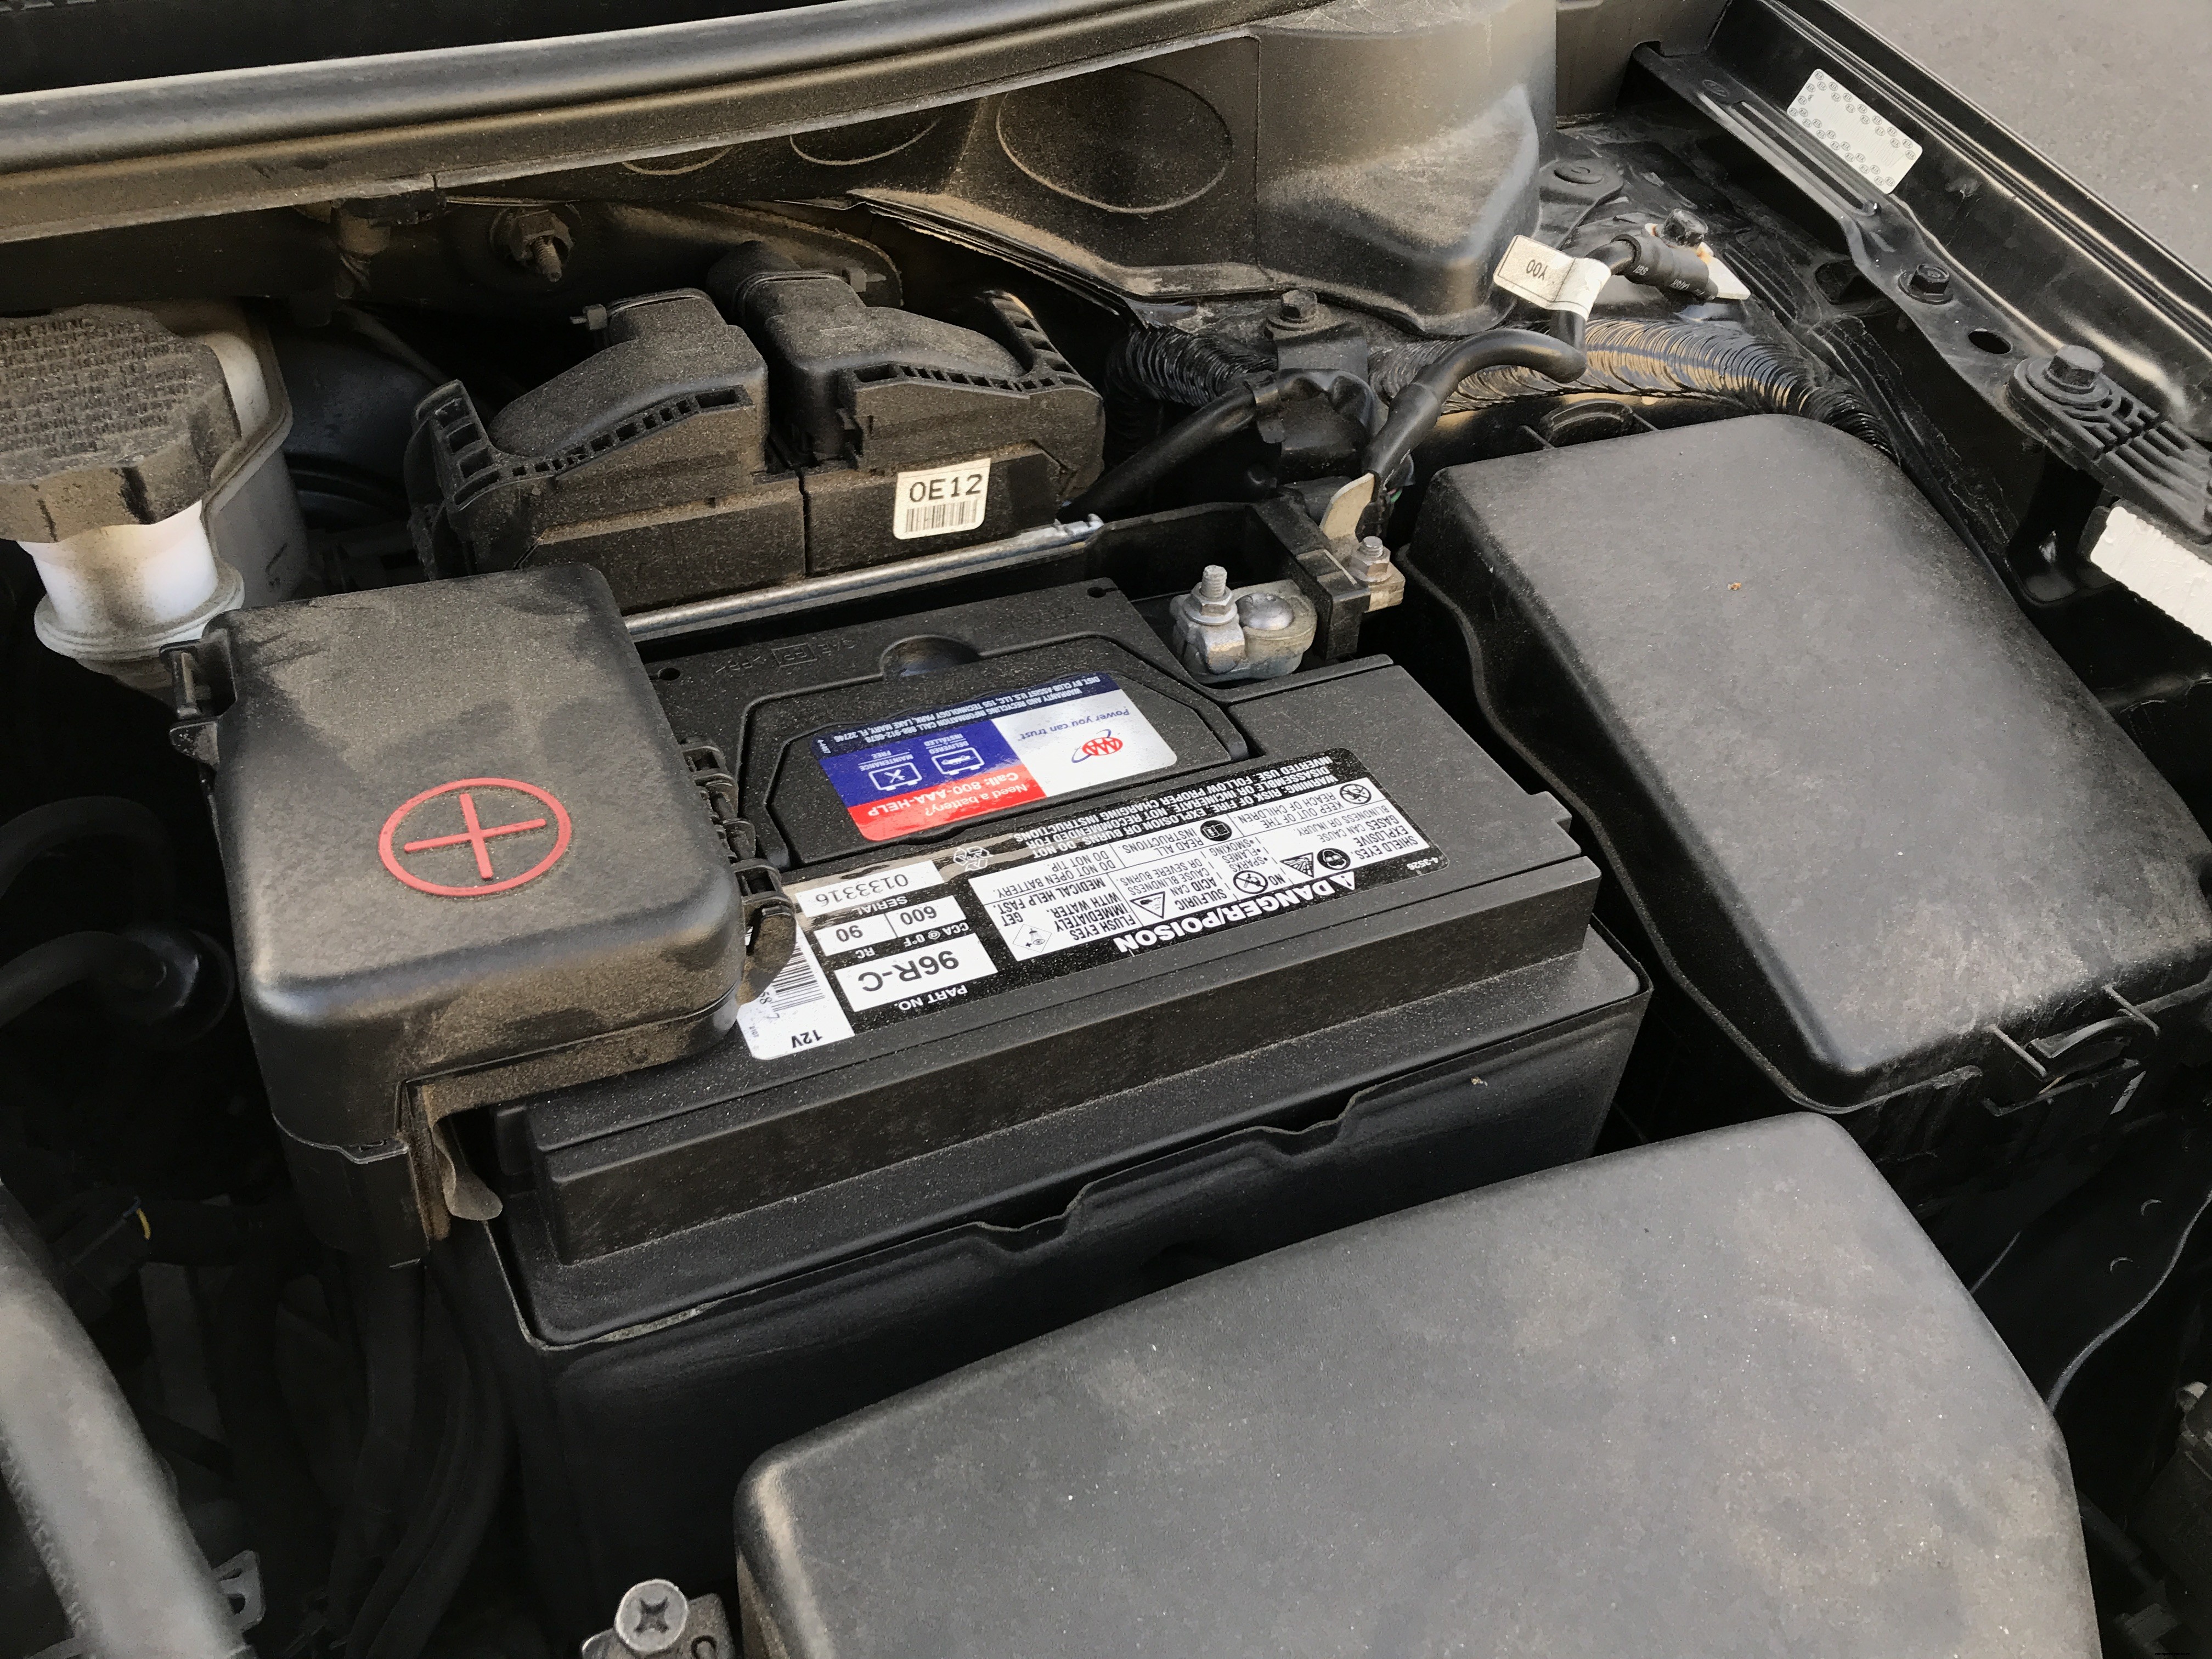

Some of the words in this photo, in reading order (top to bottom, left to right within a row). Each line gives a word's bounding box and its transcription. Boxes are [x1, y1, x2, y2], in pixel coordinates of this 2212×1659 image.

[1026, 686, 1054, 697] ASSIST
[1052, 682, 1073, 691] CLUB
[995, 695, 1013, 704] LLC,
[1011, 692, 1028, 701] U.S.
[1025, 697, 1043, 705] AND
[1041, 687, 1082, 702] WARRANTY
[934, 703, 983, 719] TECHNOLOGY
[981, 699, 997, 708] 155
[985, 701, 1026, 715] RECYCLING
[911, 713, 935, 724] PARK,
[936, 709, 987, 726] INFORMATION
[1069, 715, 1094, 726] you
[1093, 708, 1131, 722] Power
[867, 723, 893, 734] MARY,
[892, 719, 913, 729] LAKE
[916, 721, 937, 731] CALL
[1049, 723, 1069, 732] can
[833, 731, 859, 742] 32746
[923, 732, 963, 746] INSTALLED
[928, 740, 969, 754] DELIVERED
[1080, 735, 1125, 758] AAA
[858, 753, 914, 771] MAINTENANCE
[870, 750, 891, 759] FREE
[1278, 755, 1334, 775] INVERTED
[983, 771, 1020, 787] Call:
[1251, 769, 1280, 782] USE.
[1252, 766, 1331, 791] DISASSEMBLE
[991, 783, 1028, 798] Need
[1202, 775, 1254, 794] FOLLOW
[1234, 785, 1255, 795] OR
[1280, 774, 1339, 794] WARNING:
[865, 780, 983, 816] 800-AAA-HELP
[1157, 787, 1205, 805] PROPER
[1166, 789, 1238, 813] INCINERATE.
[1235, 795, 1255, 806] OF
[1252, 788, 1283, 802] RISK
[1301, 792, 1337, 806] REACH
[921, 793, 979, 816] battery?
[1098, 798, 1160, 820] CHARGING
[1205, 799, 1238, 813] FIRE,
[1286, 800, 1302, 810] OF
[1316, 800, 1344, 814] KEEP
[1137, 806, 1168, 820] NOT
[1141, 807, 1207, 830] EXPLOSION
[1233, 804, 1288, 825] CHILDREN.
[1279, 812, 1296, 823] OF
[1294, 807, 1318, 819] OUT
[1340, 805, 1390, 823] BLINDNESS
[1008, 814, 1099, 843] INSTRUCTIONS.
[1049, 813, 1141, 843] RECOMMENDED
[1121, 823, 1142, 835] OR
[1259, 816, 1281, 828] THE
[1293, 821, 1329, 836] INJURY.
[1327, 817, 1342, 827] OR
[1345, 823, 1367, 834] CAN
[1364, 815, 1400, 831] GASES
[1024, 836, 1052, 849] FOR
[1077, 828, 1124, 846] BURNS.
[1116, 827, 1198, 855] INSTRUCTIONS.
[1316, 828, 1347, 843] CAUSE
[1352, 825, 1409, 847] EXPLOSIVE
[1056, 839, 1077, 851] DO
[1153, 844, 1176, 856] ALL
[1174, 837, 1204, 850] READ
[1380, 835, 1419, 852] SHIELD
[1029, 844, 1058, 859] NOT
[1091, 850, 1109, 861] DO
[1350, 845, 1383, 860] EYES.
[1047, 860, 1069, 873] TIP.
[1068, 854, 1092, 867] NOT
[1097, 859, 1115, 871] DO
[1187, 857, 1203, 868] OR
[1404, 856, 1441, 870] 4-3526
[1074, 864, 1098, 877] NOT
[1152, 861, 1188, 877] SEVERE
[1177, 867, 1210, 882] CAUSE
[1043, 870, 1075, 884] OPEN
[1115, 871, 1153, 887] BURNS.
[1189, 877, 1218, 891] ACID
[1266, 873, 1285, 885] NO
[813, 873, 910, 907] 0133316
[992, 878, 1044, 898] BATTERY.
[1054, 877, 1106, 898] MEDICAL
[1126, 875, 1180, 896] BLINDNESS
[1169, 884, 1190, 896] CAN
[1024, 889, 1057, 906] HELP
[1089, 891, 1121, 907] WITH
[1173, 888, 1228, 911] SULFURIC
[850, 895, 909, 916] SERIAL
[992, 898, 1026, 915] FAST.
[1045, 899, 1091, 919] WATER.
[898, 904, 939, 926] 600
[998, 911, 1024, 927] GET
[1051, 902, 1129, 932] IMMEDIATELY
[1111, 878, 1336, 953] DANGER/POISON
[941, 921, 970, 935] CCA
[1098, 914, 1137, 932] FLUSH
[833, 923, 864, 943] 90
[926, 928, 941, 940] @
[1068, 924, 1100, 941] EYES
[853, 946, 876, 959] RC
[855, 949, 961, 994] 96R-C
[924, 984, 968, 1003] PART
[893, 997, 924, 1012] NO.
[788, 1028, 823, 1048] 12V
